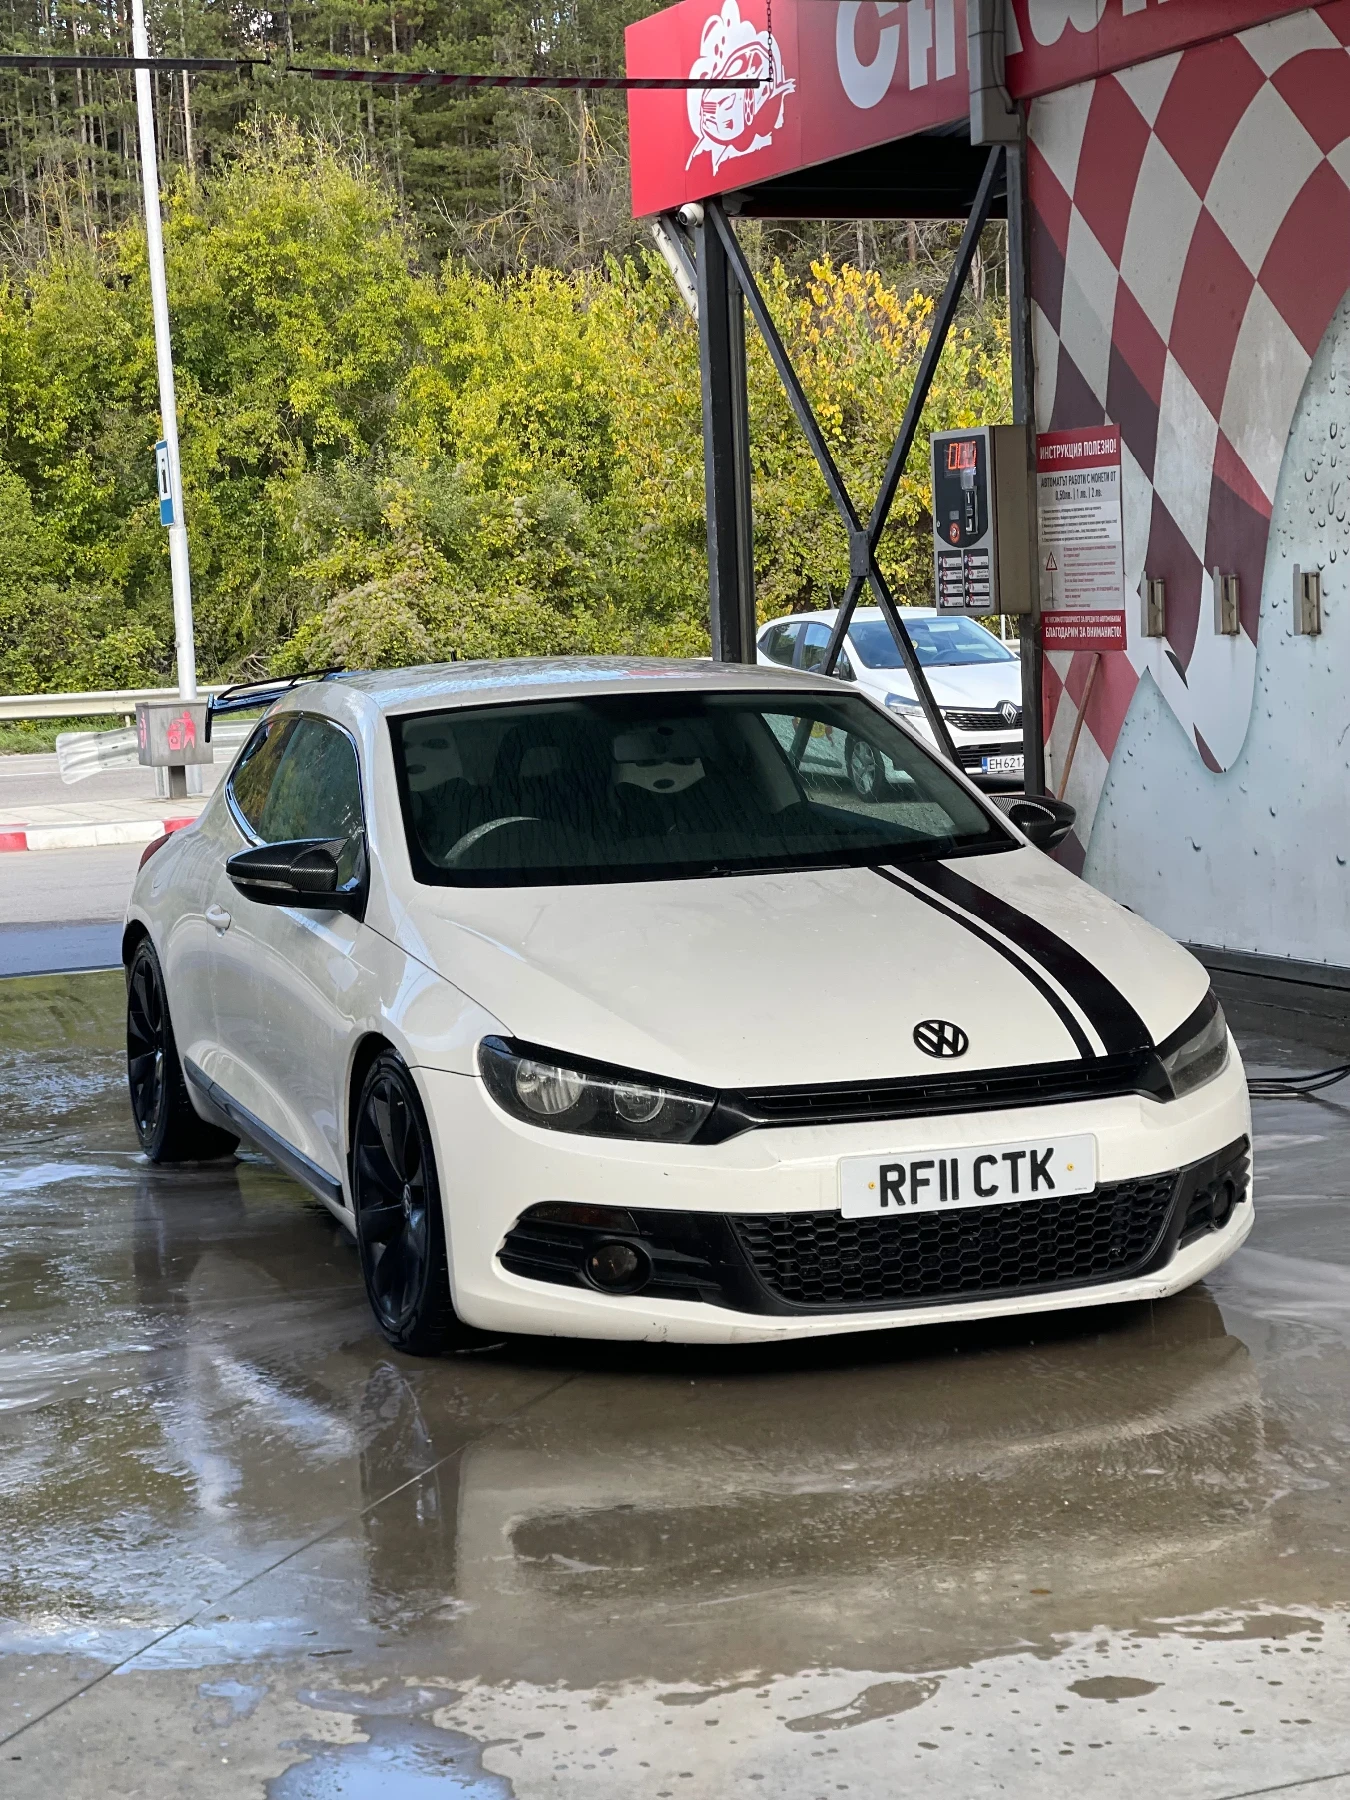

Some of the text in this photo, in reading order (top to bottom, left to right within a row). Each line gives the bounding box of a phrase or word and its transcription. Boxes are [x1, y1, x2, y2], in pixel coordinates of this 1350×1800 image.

[1039, 438, 1117, 460] ИНСТРУКЦИЯ ПОЛЕЗНО!
[1041, 475, 1068, 488] АВТОМАТЪТ
[1068, 473, 1086, 486] РАБОТИ
[1091, 471, 1110, 483] МОНЕТИ
[1110, 470, 1117, 482] ОТ
[1045, 626, 1123, 639] БЛАГОДАРИМ ЗА ВНИМАНИЕТО!
[879, 1147, 1056, 1208] RF11 CTK
